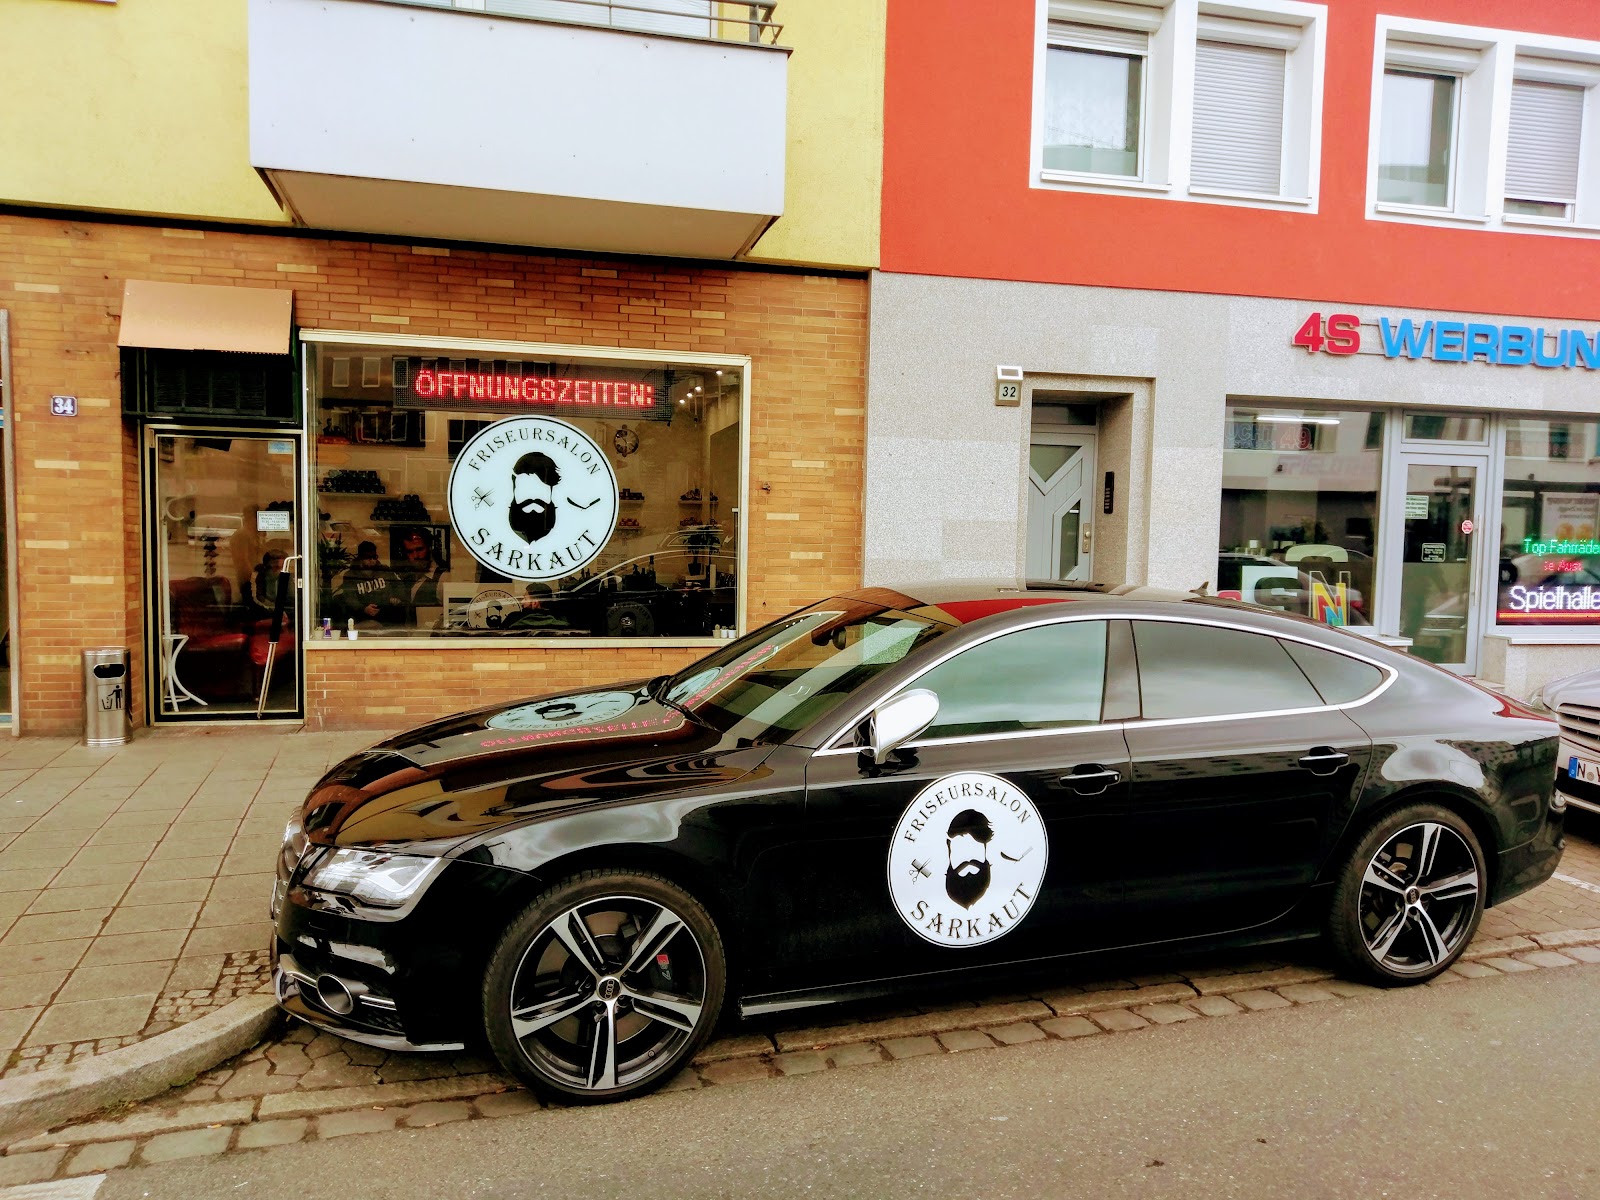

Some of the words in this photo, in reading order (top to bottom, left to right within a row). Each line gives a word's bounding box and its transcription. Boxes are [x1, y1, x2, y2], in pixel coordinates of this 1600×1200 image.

[1291, 312, 1361, 355] 4S
[1378, 316, 1600, 370] WERBUN
[53, 397, 74, 415] 34
[415, 369, 655, 406] ÖFFNUNGSZEITEN:
[1002, 386, 1017, 398] 32
[467, 427, 602, 476] FRISEURSALON
[470, 529, 598, 571] SARKAUT
[1523, 538, 1547, 556] Top
[1508, 585, 1600, 613] Spielhalle
[903, 782, 1032, 843] FRISEURSALON
[910, 882, 1033, 939] SARKAUT
